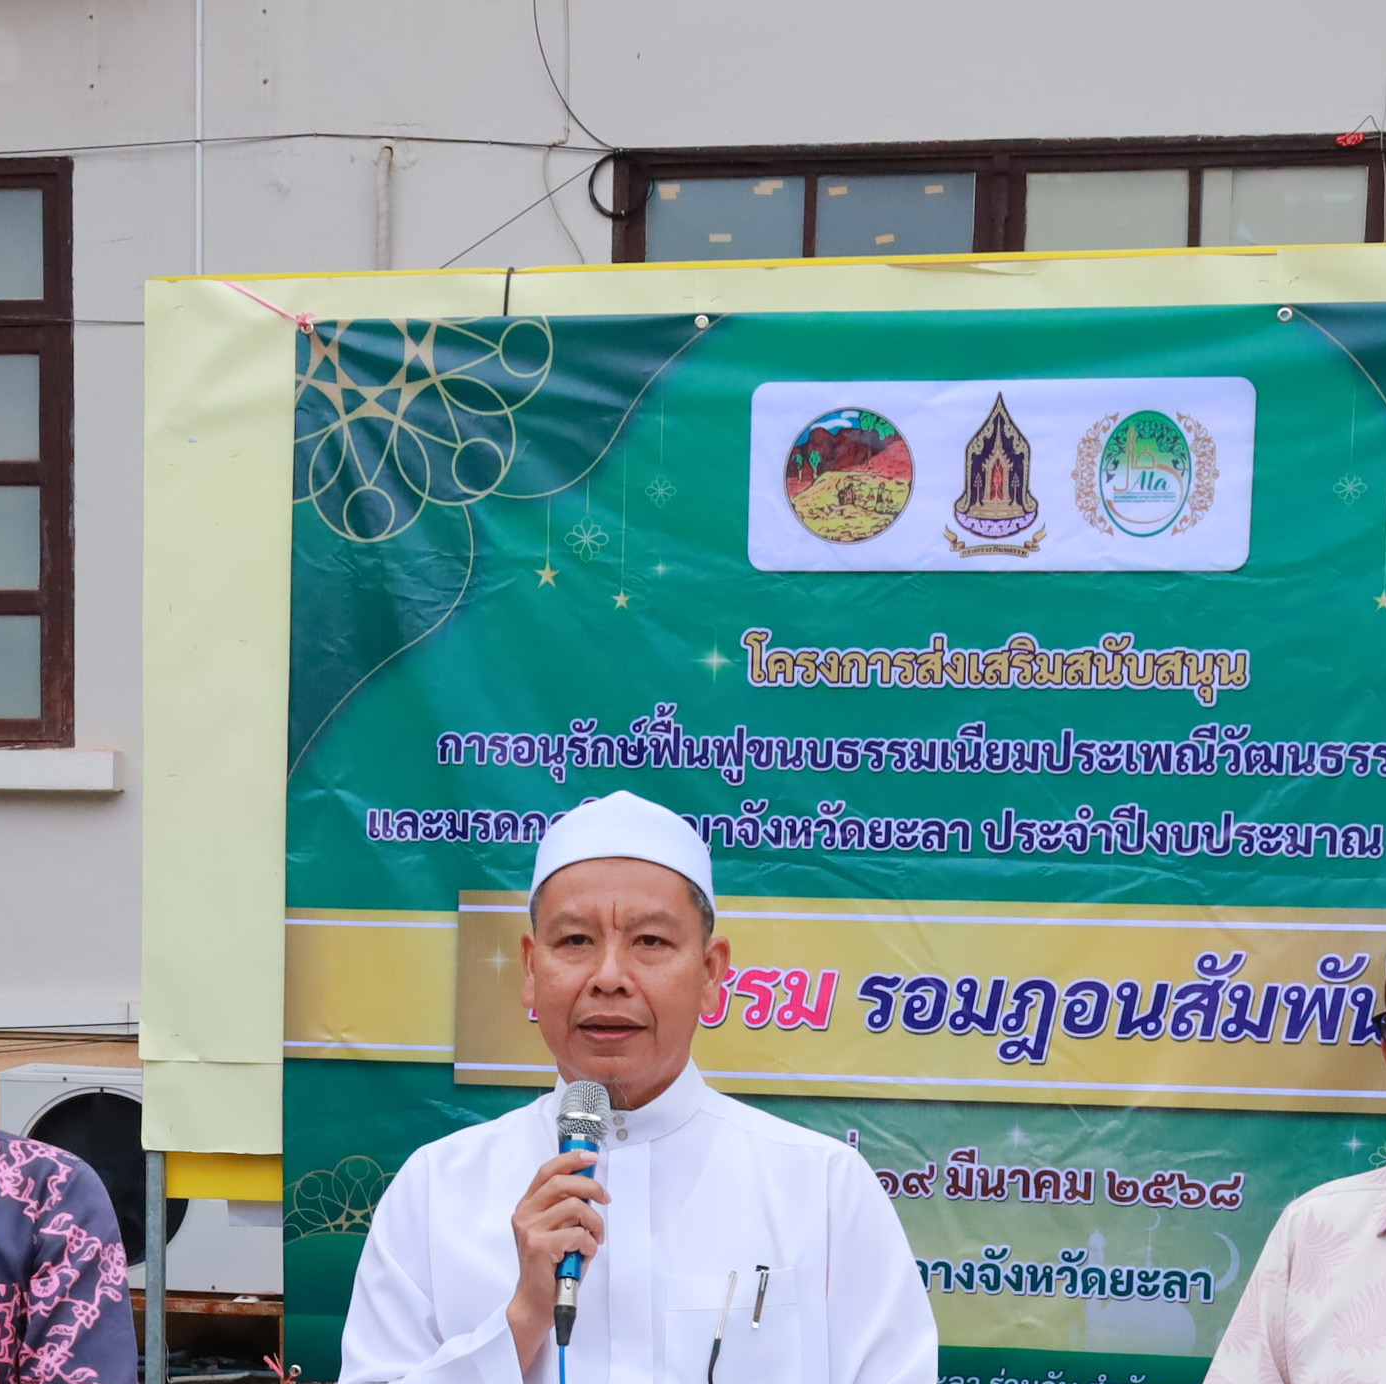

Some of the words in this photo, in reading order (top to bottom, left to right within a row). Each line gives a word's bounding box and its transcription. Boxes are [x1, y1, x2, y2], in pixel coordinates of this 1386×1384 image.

[741, 627, 1250, 706] โครงการส่งเสริมสนับสนุน
[981, 804, 1383, 860] ประจำปีงบประมาณ
[856, 951, 1382, 1064] รอมฎอนสัมพัน
[945, 1146, 1095, 1204] มีนาคม
[1105, 1166, 1245, 1209] ๒๕๖๘
